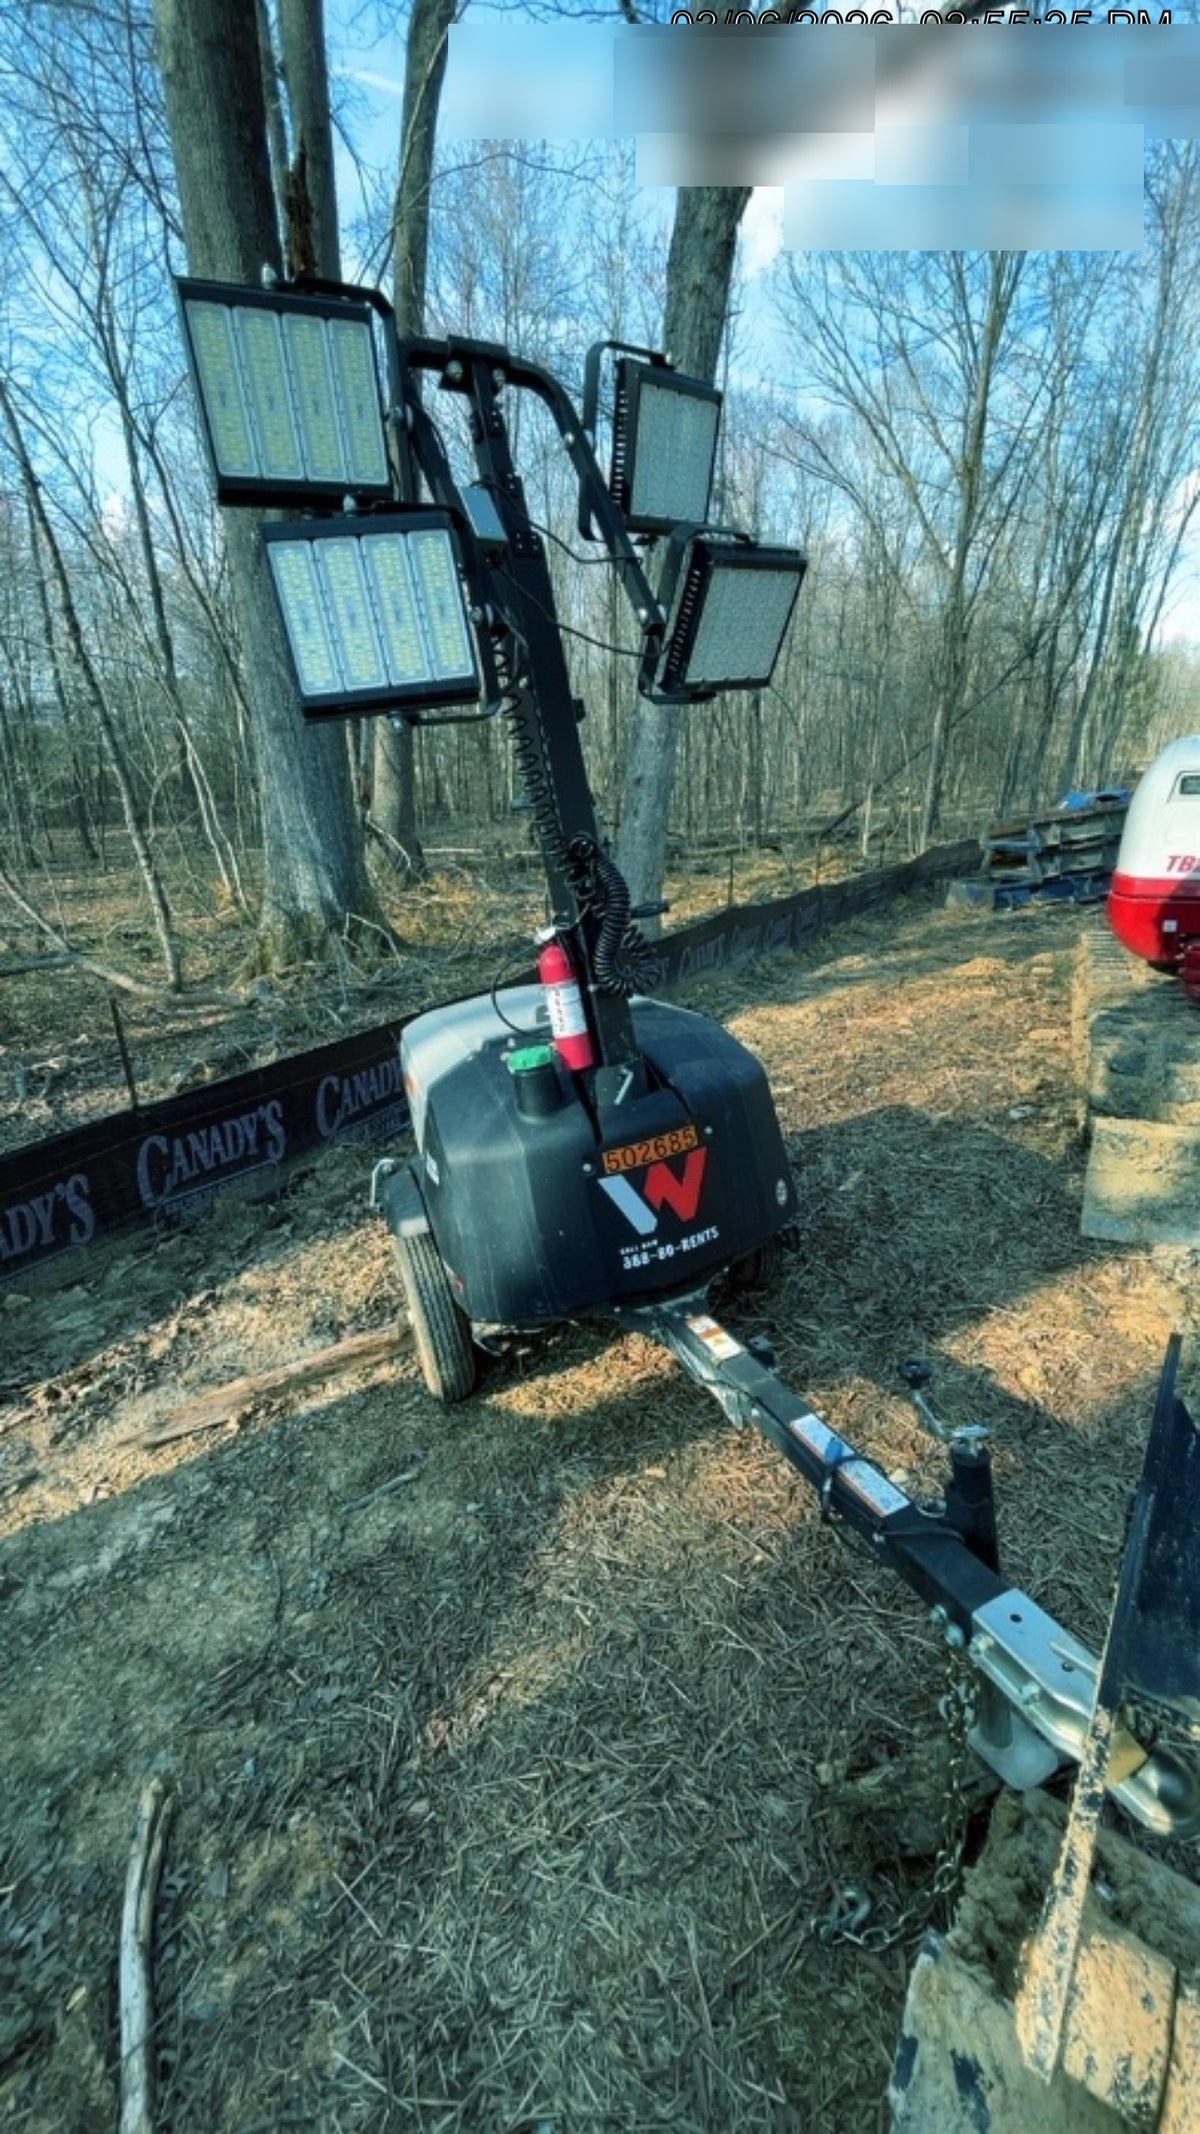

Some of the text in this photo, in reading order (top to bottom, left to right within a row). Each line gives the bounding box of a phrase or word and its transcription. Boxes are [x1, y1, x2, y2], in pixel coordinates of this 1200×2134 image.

[316, 1056, 402, 1137] CANADY
[136, 1099, 287, 1208] CANADY'S
[605, 1127, 693, 1173] 502685
